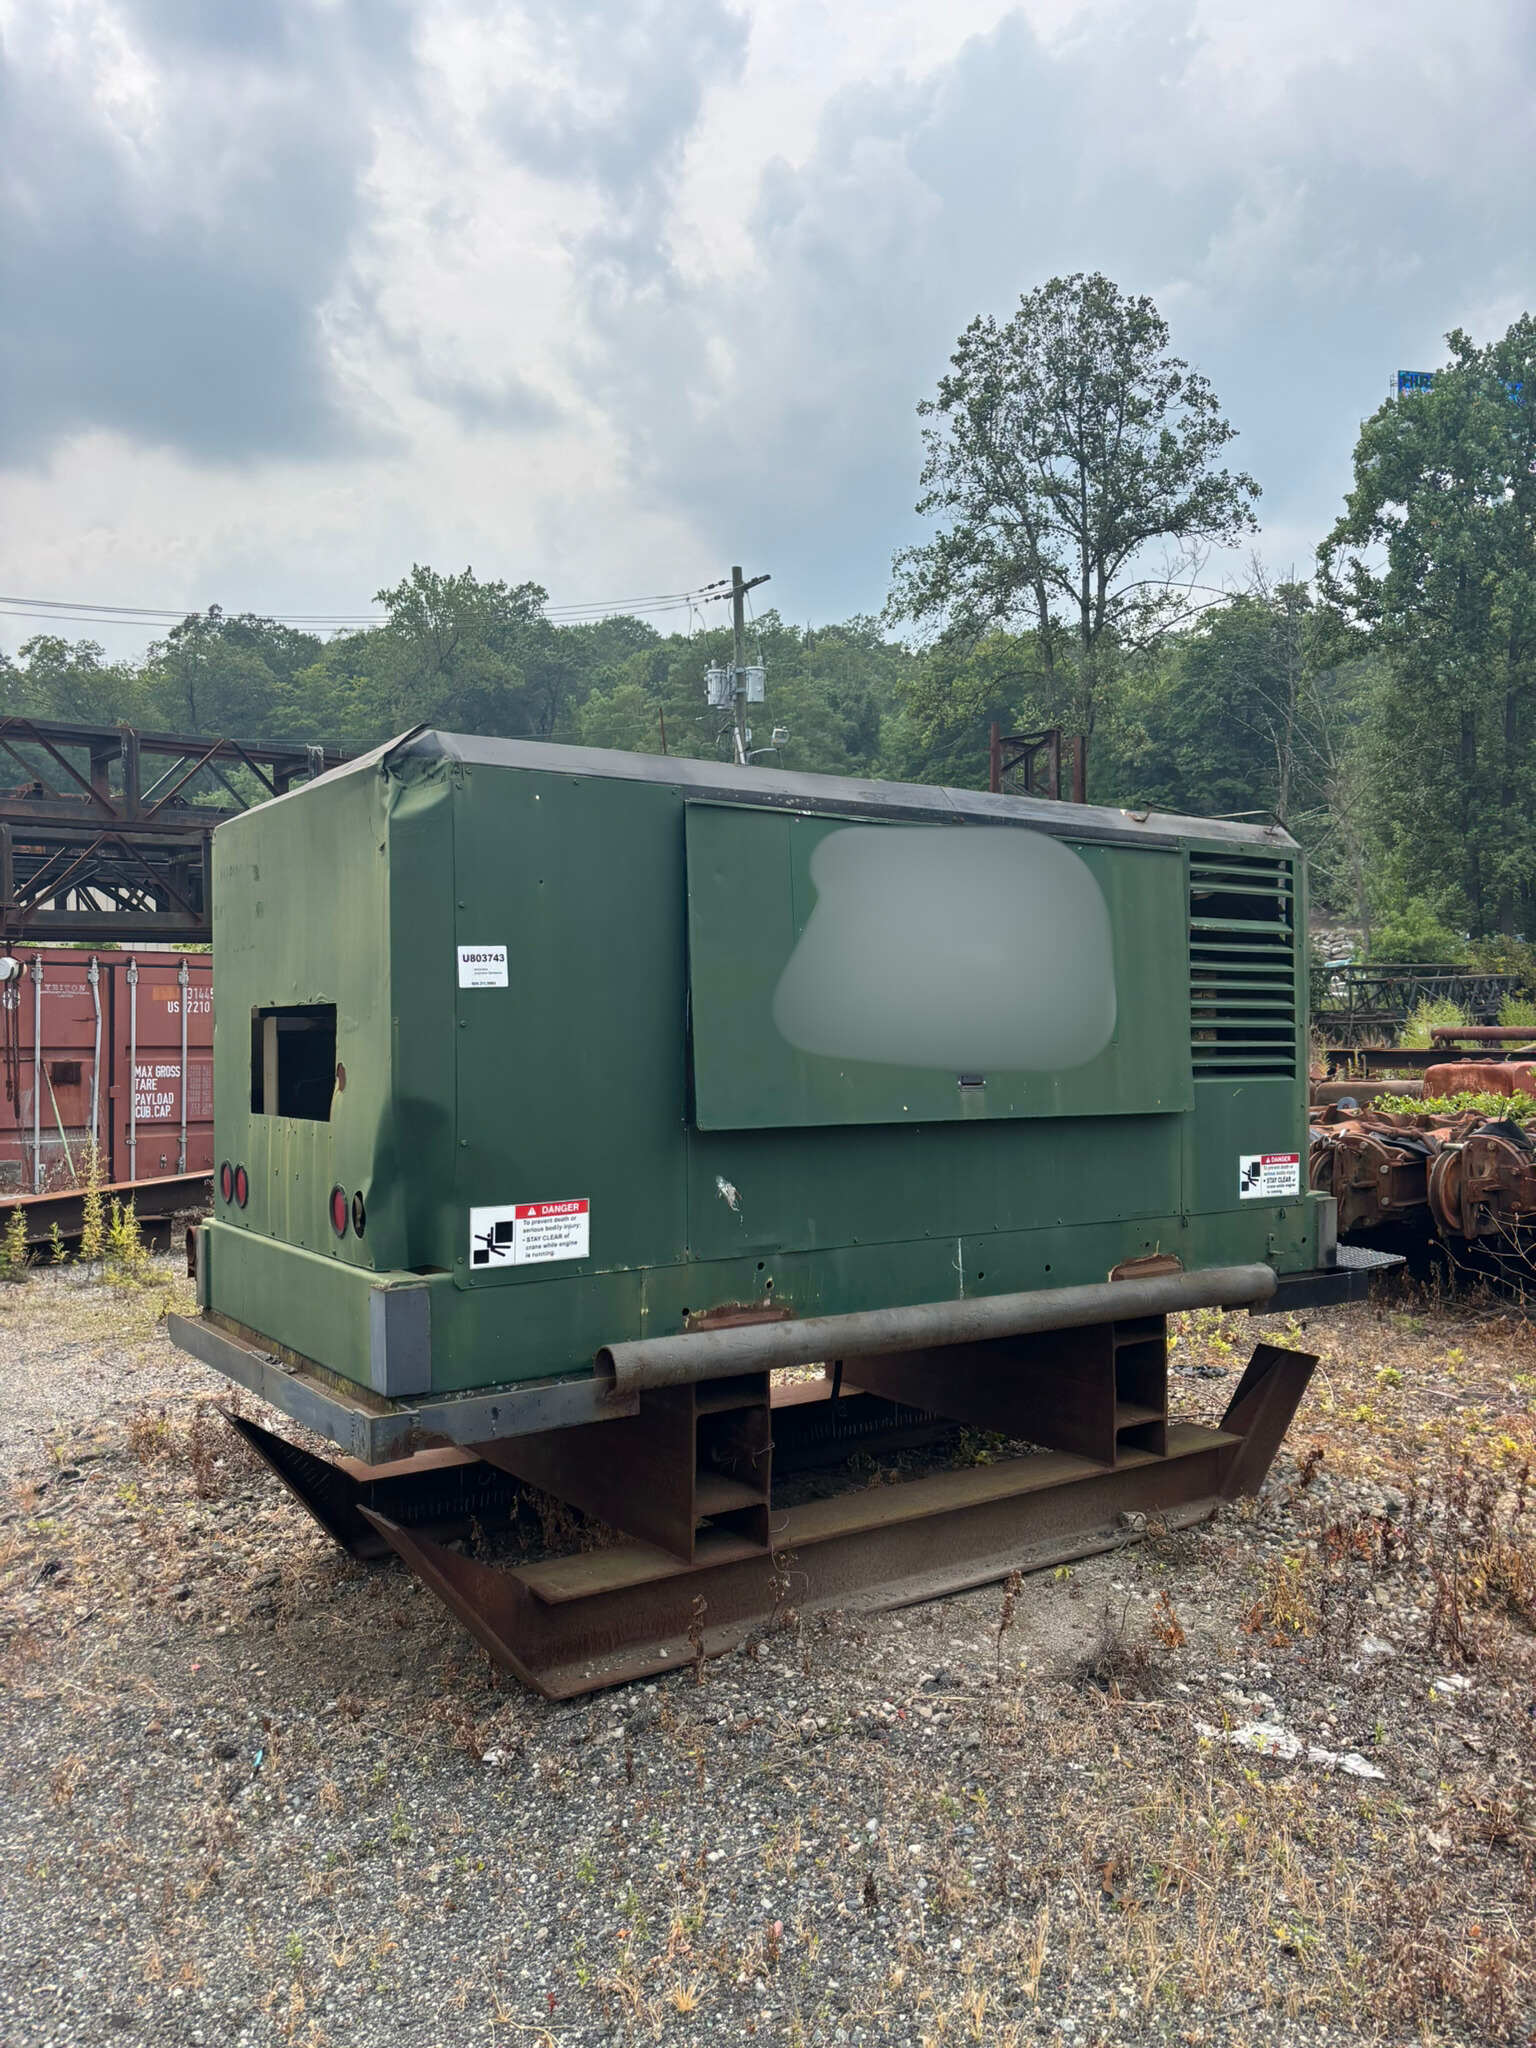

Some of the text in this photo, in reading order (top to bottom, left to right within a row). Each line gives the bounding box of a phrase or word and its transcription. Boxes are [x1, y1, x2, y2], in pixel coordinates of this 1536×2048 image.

[462, 953, 505, 963] U803743
[45, 984, 86, 992] TRITON
[167, 1001, 210, 1013] US 2210
[135, 1065, 153, 1078] MAX
[155, 1065, 181, 1078] GROSS
[135, 1078, 158, 1091] TARE
[135, 1092, 175, 1106] PAYLOAD
[541, 1203, 579, 1215] DANGER
[531, 1218, 553, 1226] prevent
